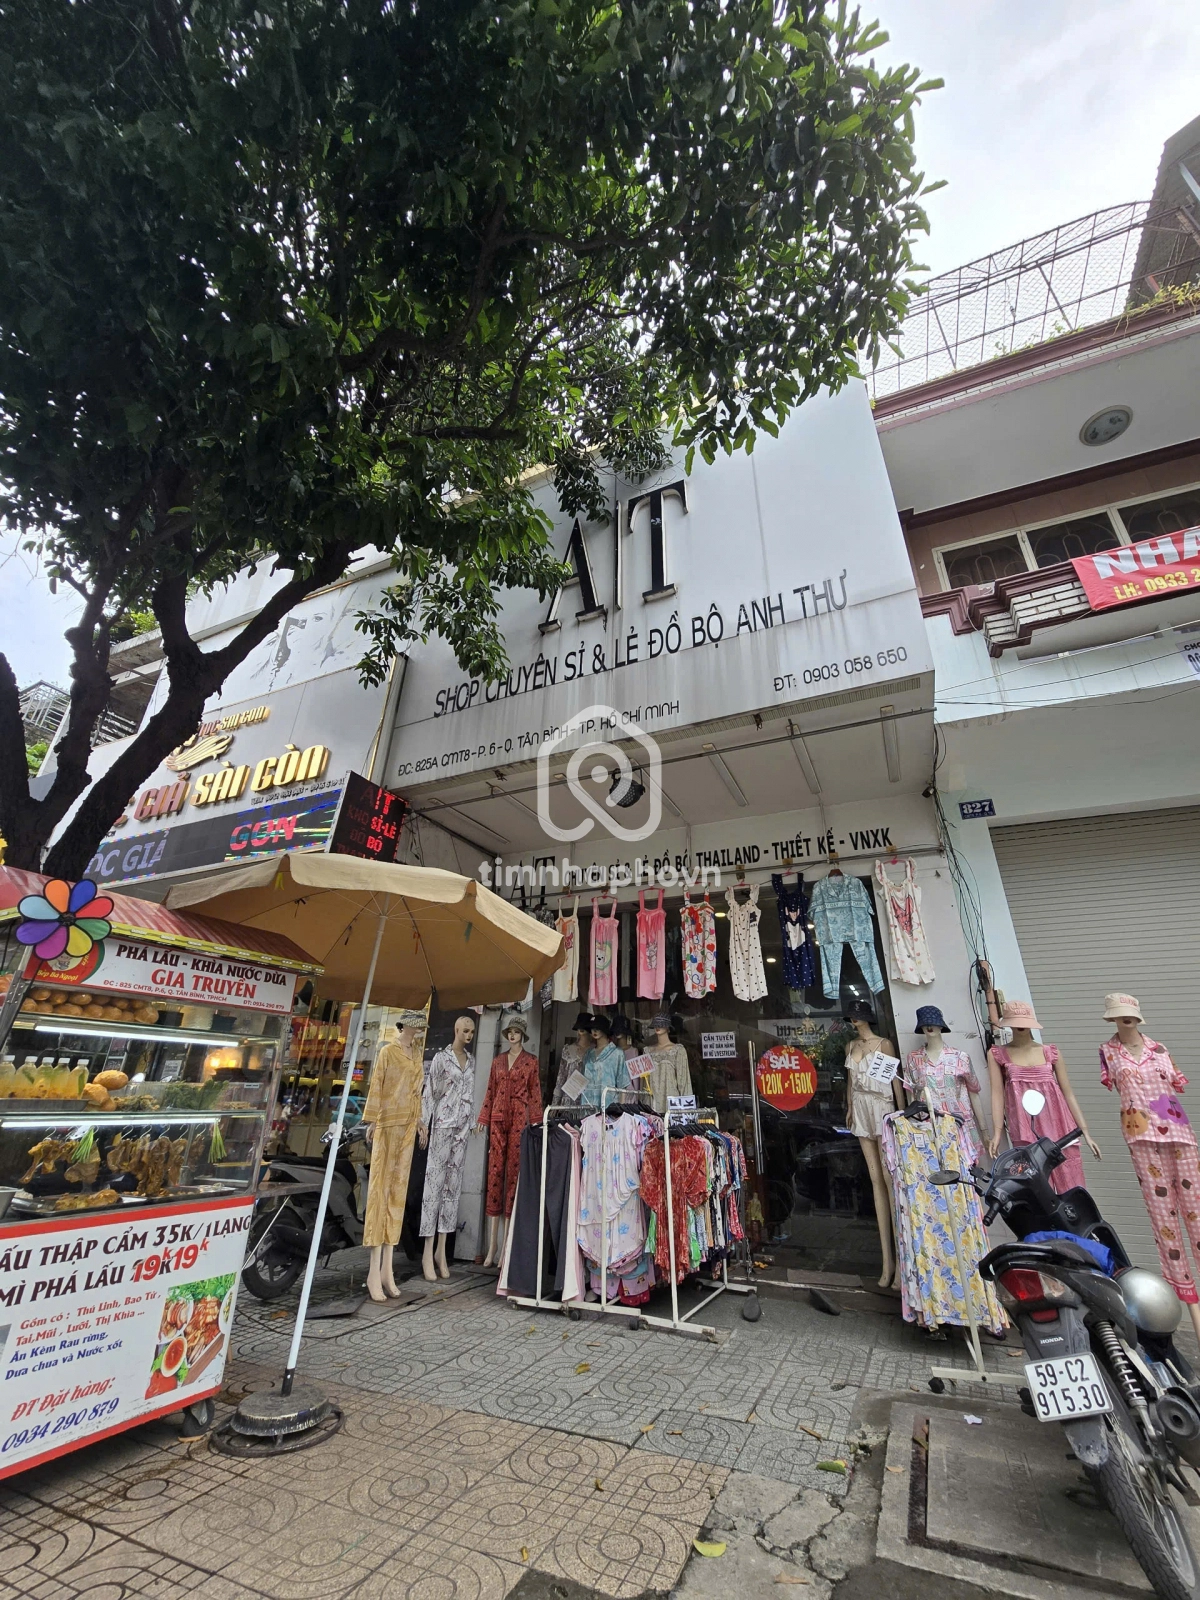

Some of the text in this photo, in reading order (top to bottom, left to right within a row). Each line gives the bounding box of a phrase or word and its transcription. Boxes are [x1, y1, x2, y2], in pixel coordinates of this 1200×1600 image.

[1113, 582, 1142, 600] LH:
[1144, 571, 1188, 592] 0933
[434, 569, 847, 718] SHOP CHUYÊN SỈ & LẺ ĐỒ BỘ ANH THƯ
[774, 646, 907, 692] ĐT: 0903 058 650
[398, 764, 413, 777] ĐC:
[415, 757, 438, 772] 825A
[518, 732, 539, 748] TÂN
[579, 719, 596, 734] TP.
[622, 705, 641, 725] CHÍ
[645, 700, 679, 720] MINH
[134, 771, 190, 821] GIẢ
[190, 760, 250, 807] SÀI
[250, 743, 329, 792] GÒN
[962, 801, 990, 814] 827
[696, 841, 760, 869] THAILAND
[772, 831, 811, 860] THIẾT
[817, 827, 836, 855] KẾ
[849, 827, 893, 850] VNXK
[116, 943, 149, 961] PHÁ
[152, 949, 180, 967] LẤU
[190, 958, 223, 975] KHÌA
[226, 964, 264, 982] NƯỚC
[264, 971, 287, 986] DỪA
[119, 981, 131, 989] 825
[151, 968, 257, 999] GIA TRUYỀN
[770, 1053, 800, 1069] SALE
[870, 1053, 885, 1078] SALE
[761, 1073, 783, 1094] 120K
[789, 1072, 814, 1094] 150K
[39, 1237, 98, 1266] THẬP
[102, 1226, 149, 1255] CẨM
[29, 1270, 79, 1302] PHÁ
[83, 1261, 126, 1291] LẤU
[50, 1312, 64, 1323] có
[77, 1305, 95, 1317] Thú
[124, 1296, 142, 1306] Bao
[95, 1315, 111, 1327] Thị
[29, 1344, 56, 1359] Kèm
[58, 1338, 80, 1350] Rau
[1040, 1336, 1064, 1345] HONDA
[5, 1338, 124, 1381] Dưa chua và Nước xốt
[1034, 1358, 1090, 1388] 59-C2
[10, 1377, 116, 1422] ĐT Đặt hàng:
[1037, 1383, 1106, 1416] 915.30
[1, 1397, 120, 1453] 0934 290 879
